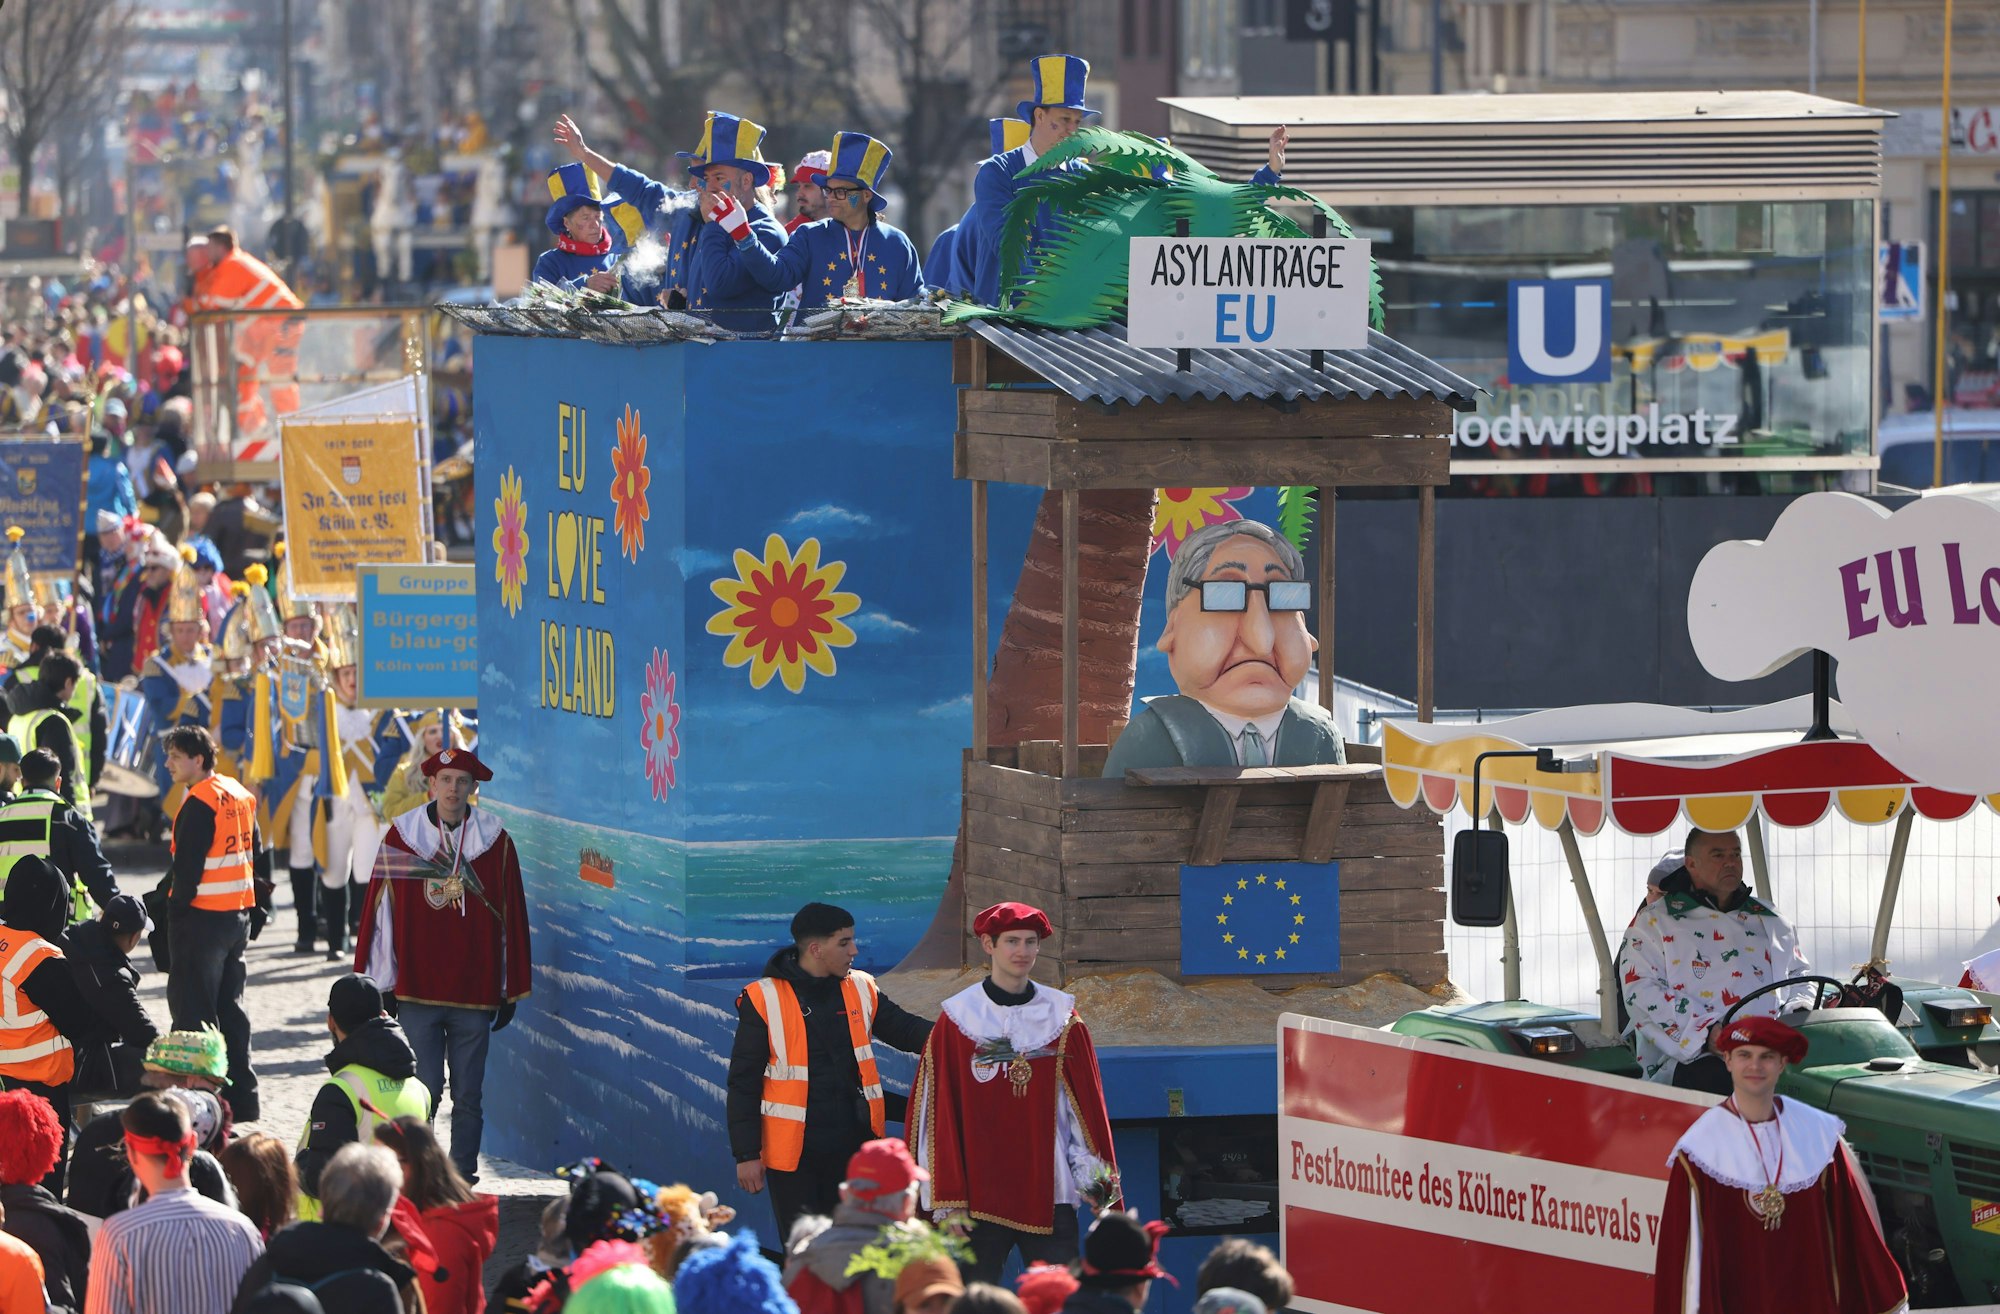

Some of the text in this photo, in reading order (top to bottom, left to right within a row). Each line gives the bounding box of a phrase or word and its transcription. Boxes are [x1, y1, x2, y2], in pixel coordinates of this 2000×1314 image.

[1151, 244, 1345, 288] ASYLANTRÄGE
[1216, 294, 1276, 343] EU
[1517, 285, 1602, 376] U
[559, 401, 586, 494] EU
[400, 576, 468, 591] Gruppe
[1838, 545, 1927, 641] EU
[375, 659, 412, 672] Köln
[416, 661, 445, 672] von
[541, 619, 616, 719] ISLAND
[1291, 1140, 1413, 1201] Festkomitee
[1419, 1163, 1453, 1208] des
[1457, 1170, 1527, 1222] Kölner
[1531, 1183, 1641, 1244] Karnevals
